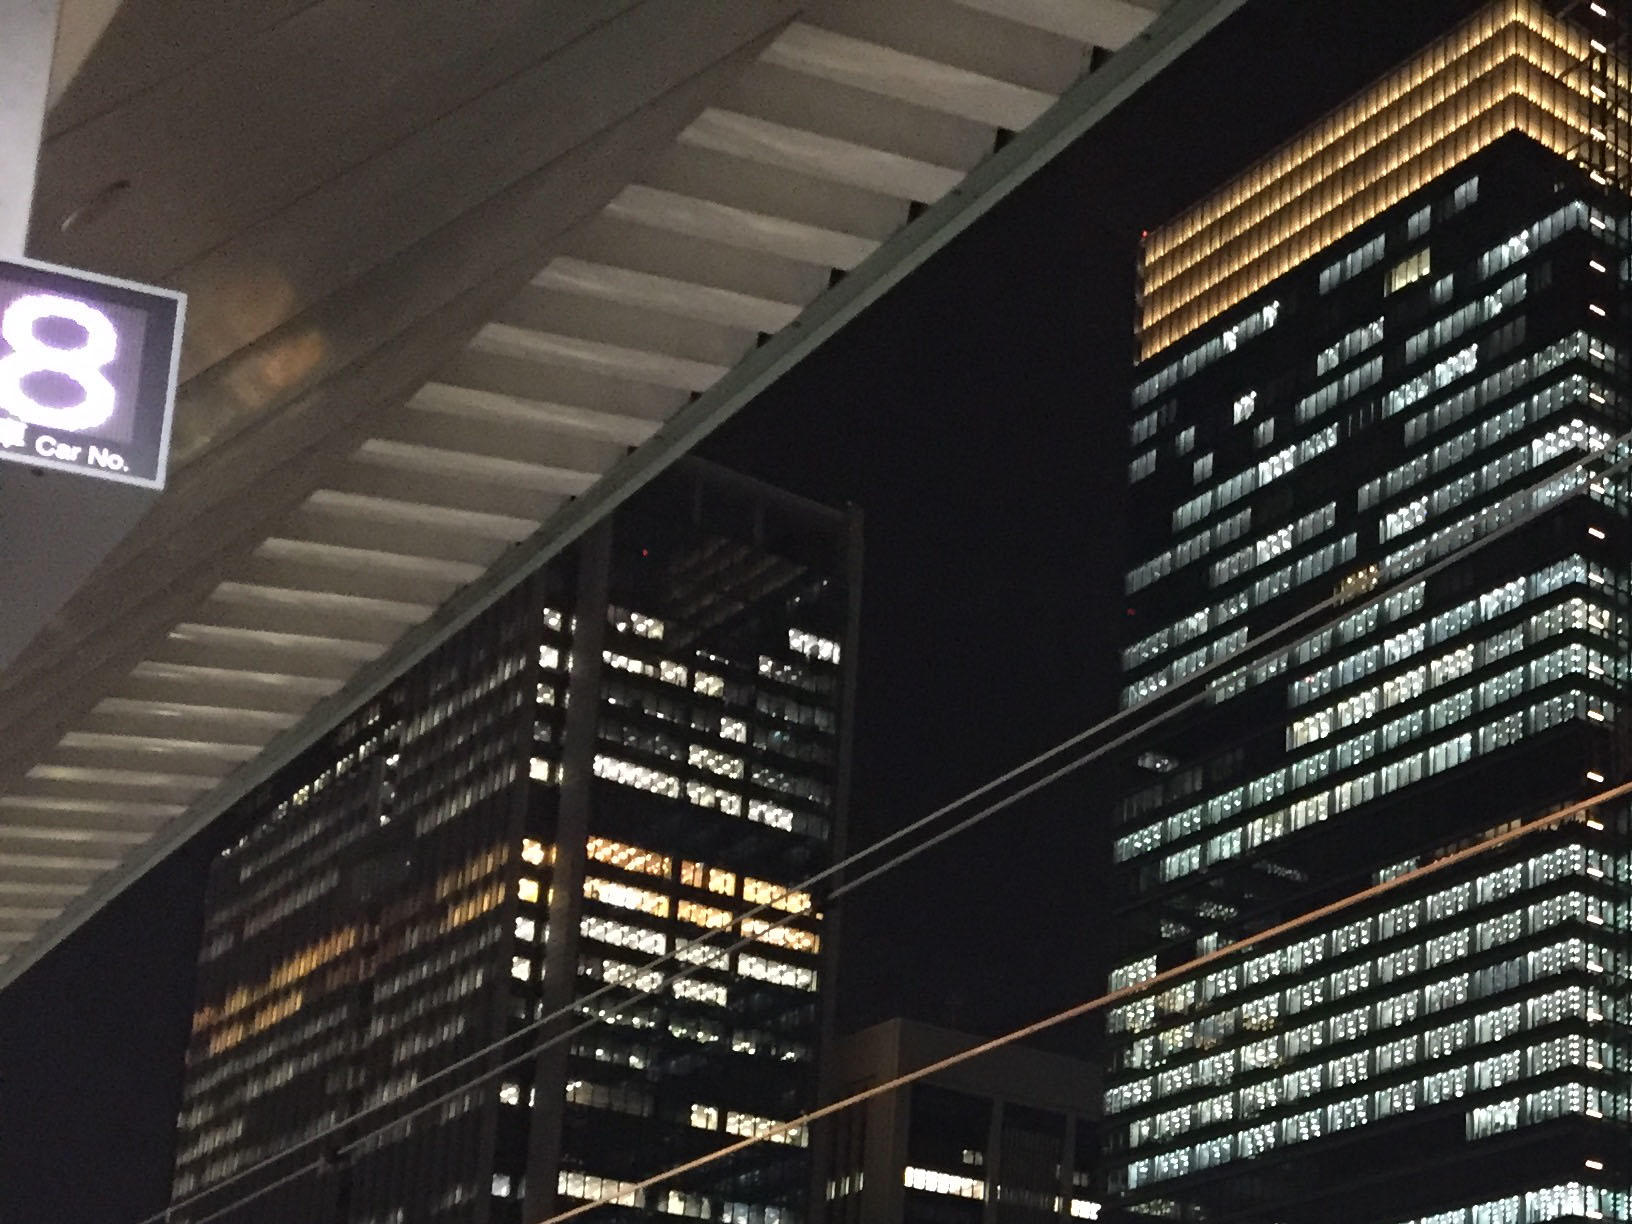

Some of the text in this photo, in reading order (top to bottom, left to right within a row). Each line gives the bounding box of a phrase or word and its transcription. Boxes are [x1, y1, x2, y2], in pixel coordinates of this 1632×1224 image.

[0, 294, 118, 432] 8
[35, 435, 129, 472] Car No.
